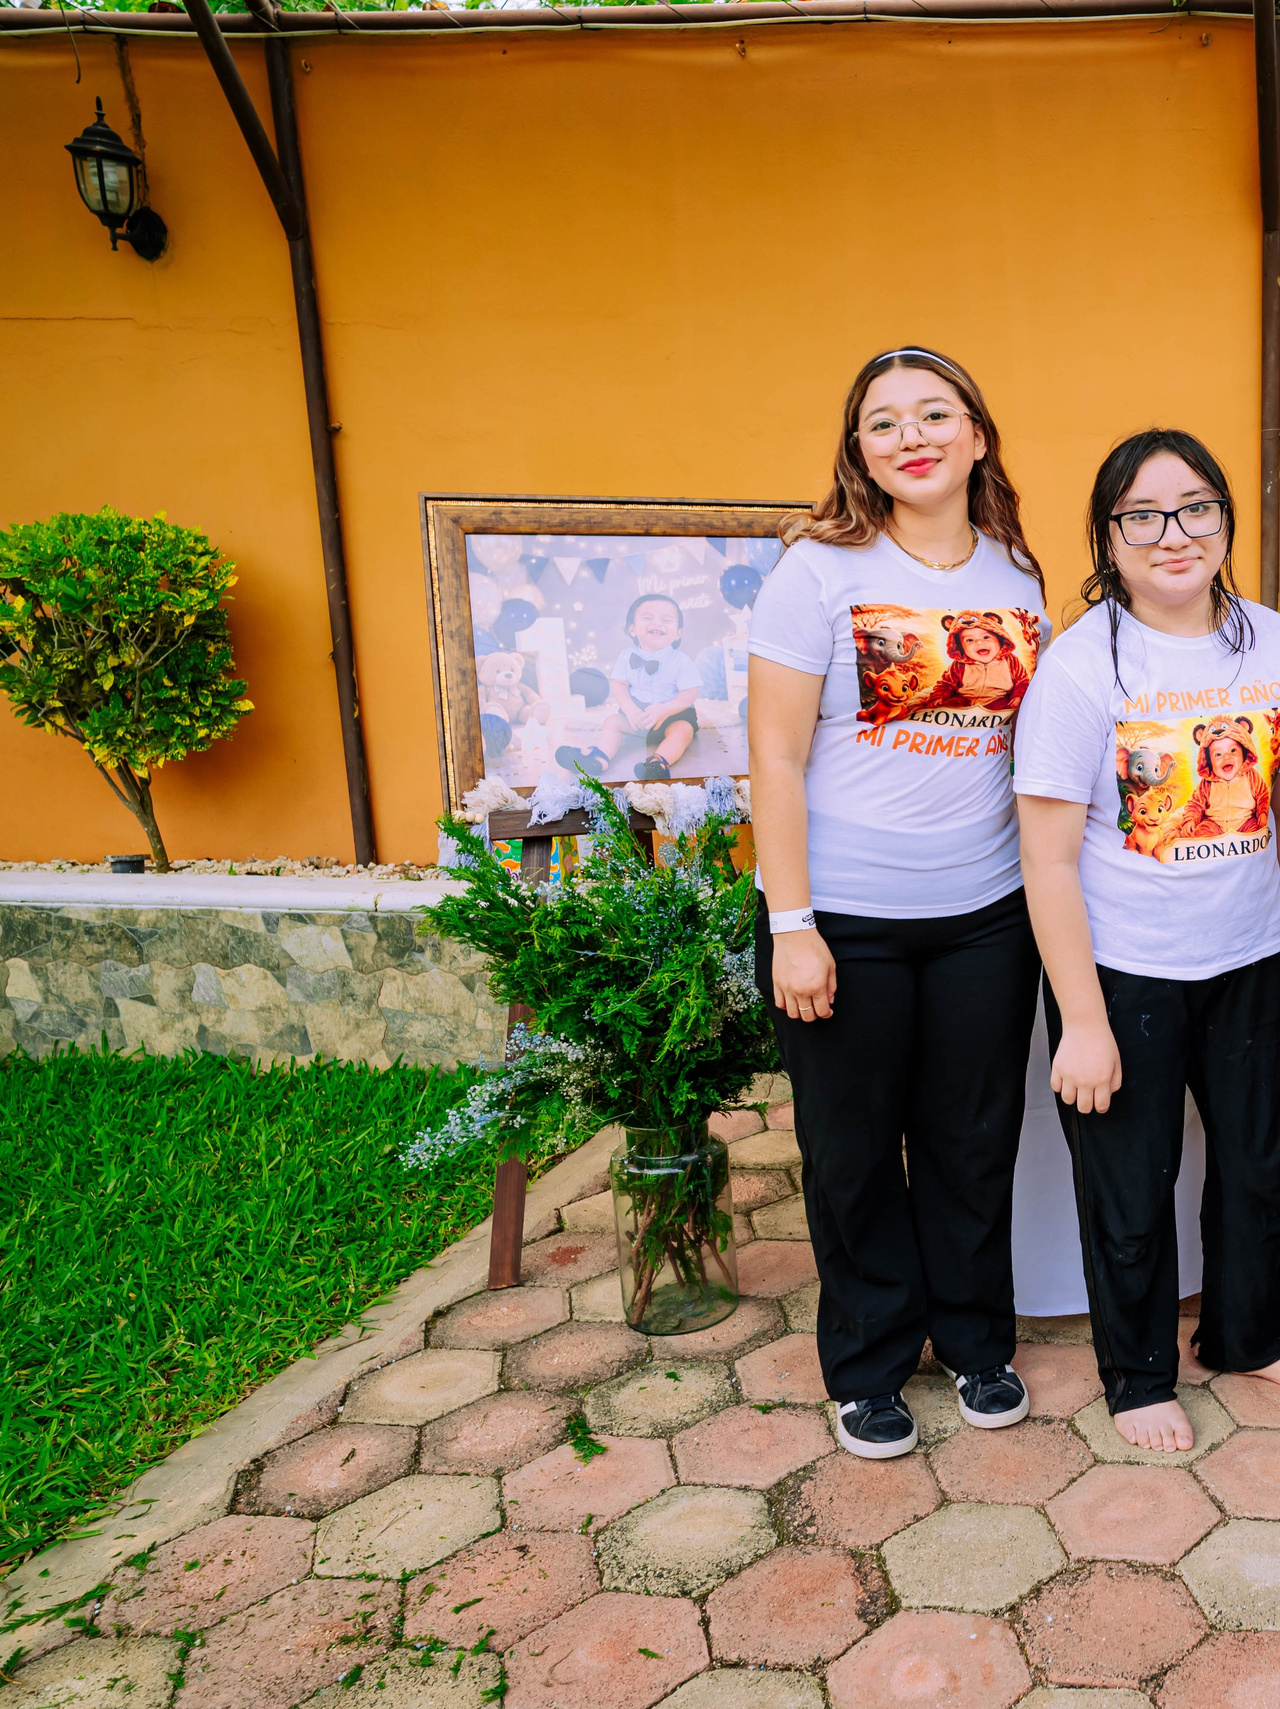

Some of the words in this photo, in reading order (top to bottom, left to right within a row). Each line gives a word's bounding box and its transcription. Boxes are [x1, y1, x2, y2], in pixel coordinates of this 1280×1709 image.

[1123, 693, 1150, 715] MI
[1156, 687, 1232, 713] PRIMER
[908, 710, 1003, 729] LEONARD
[855, 725, 886, 747] MI
[892, 729, 980, 757] PRIMER
[1174, 835, 1268, 862] LEONARDO
